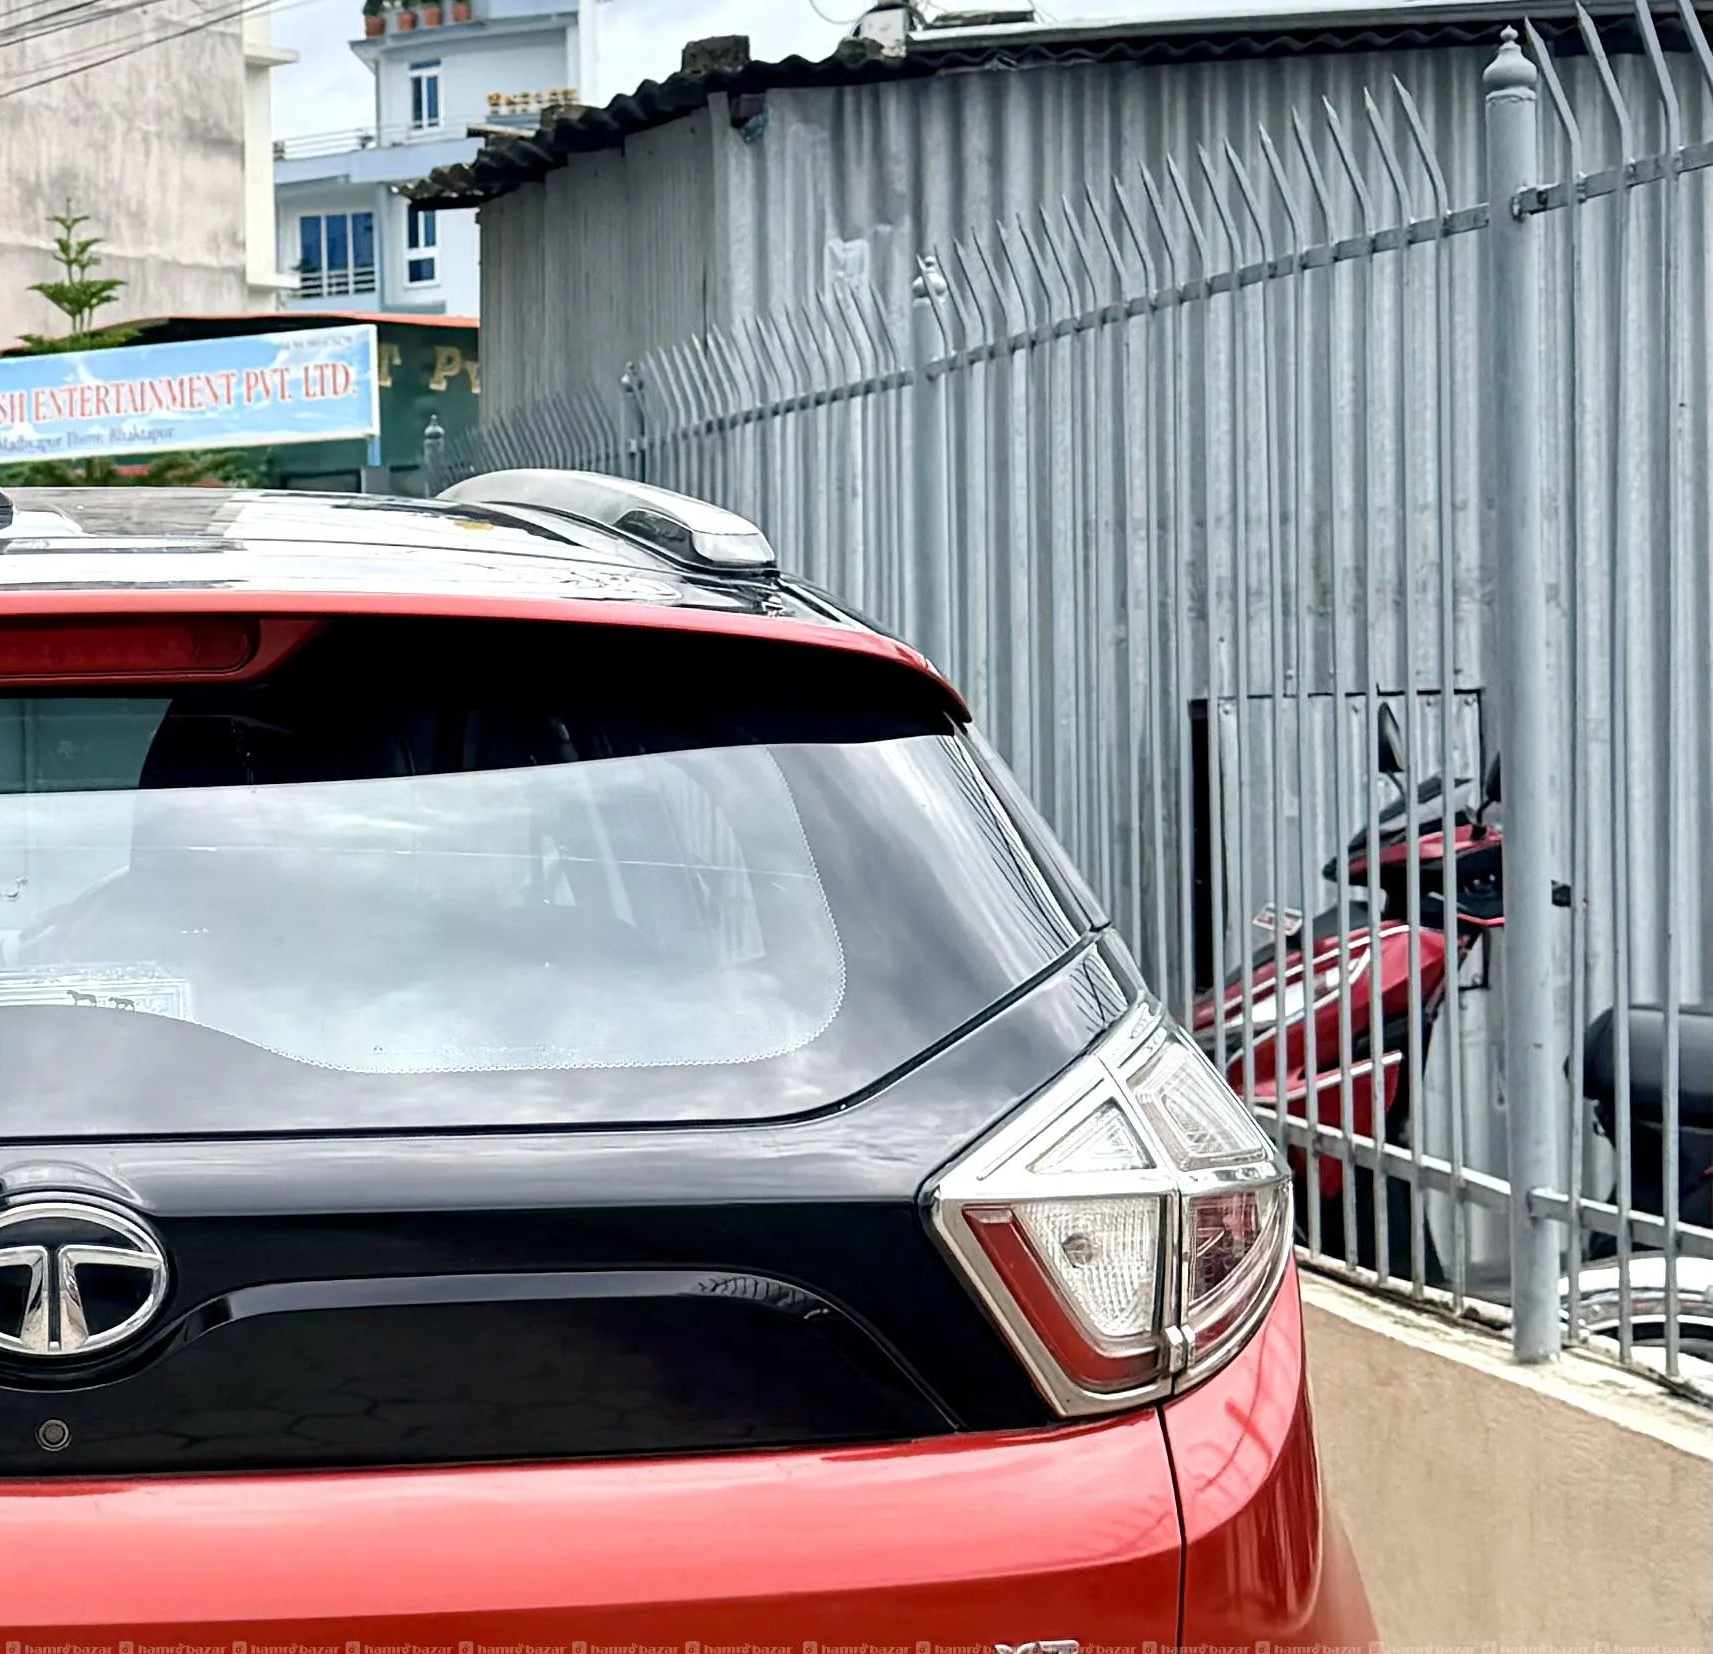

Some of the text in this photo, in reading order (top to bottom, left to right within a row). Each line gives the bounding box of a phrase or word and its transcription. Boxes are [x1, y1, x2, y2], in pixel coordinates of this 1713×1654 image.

[33, 371, 236, 421] ENTERTAINMENT
[245, 367, 292, 403] PVT.
[303, 362, 356, 398] LTD.
